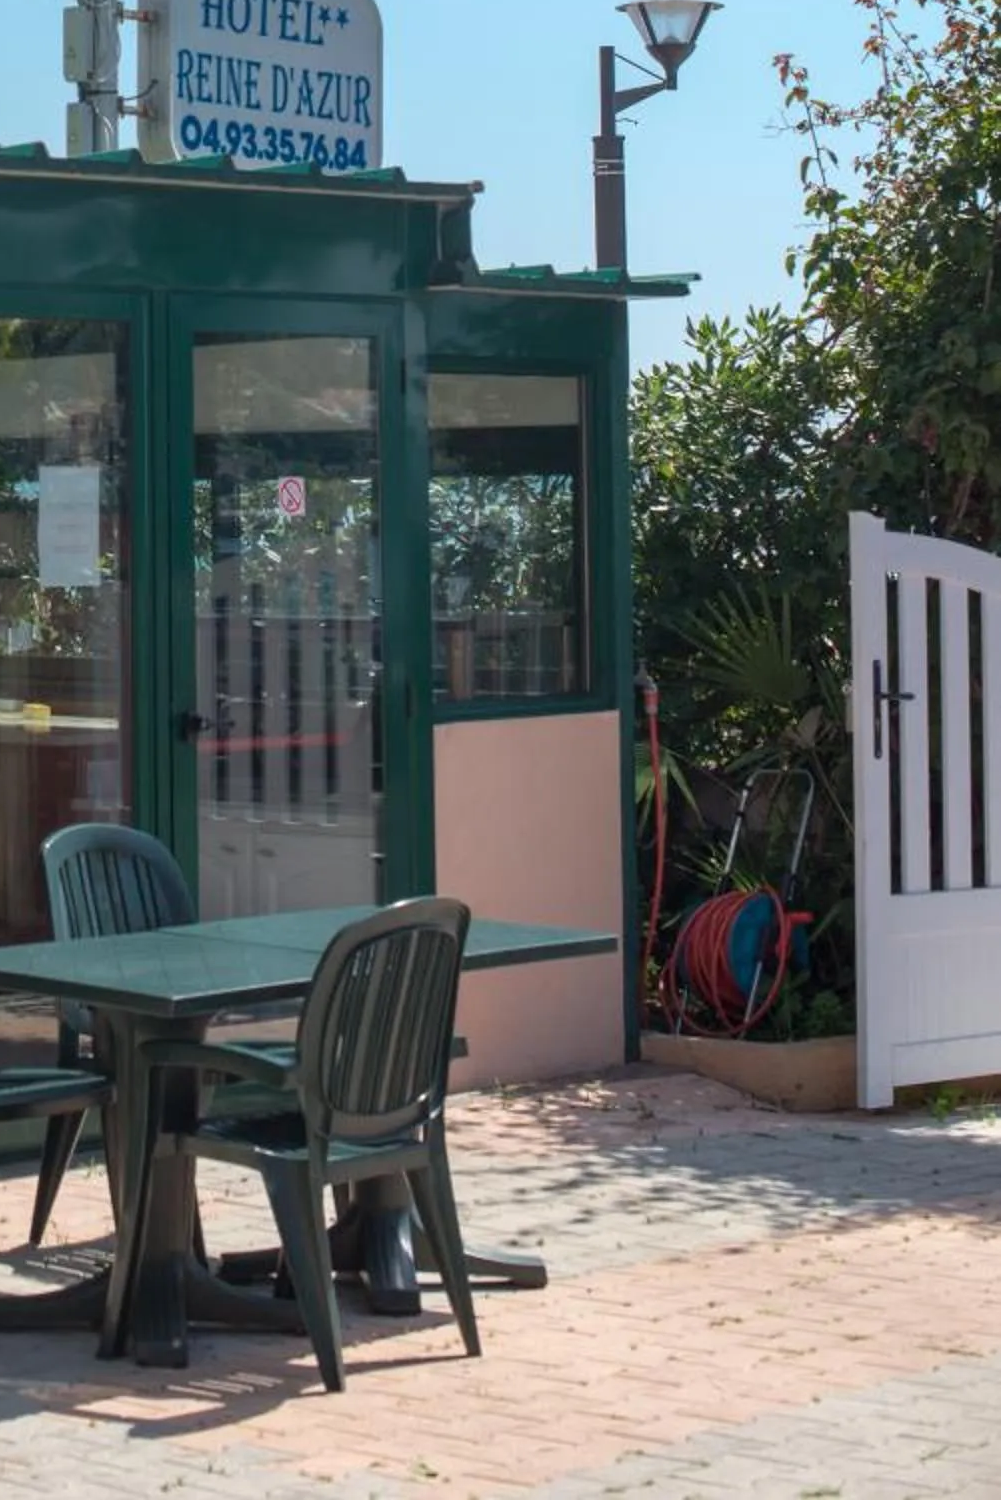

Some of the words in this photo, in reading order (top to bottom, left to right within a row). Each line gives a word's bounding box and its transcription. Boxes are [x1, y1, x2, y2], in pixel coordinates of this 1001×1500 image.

[177, 48, 261, 111] REINE
[272, 64, 371, 128] D'AZUR
[180, 115, 366, 170] 04.93.35.76.84
